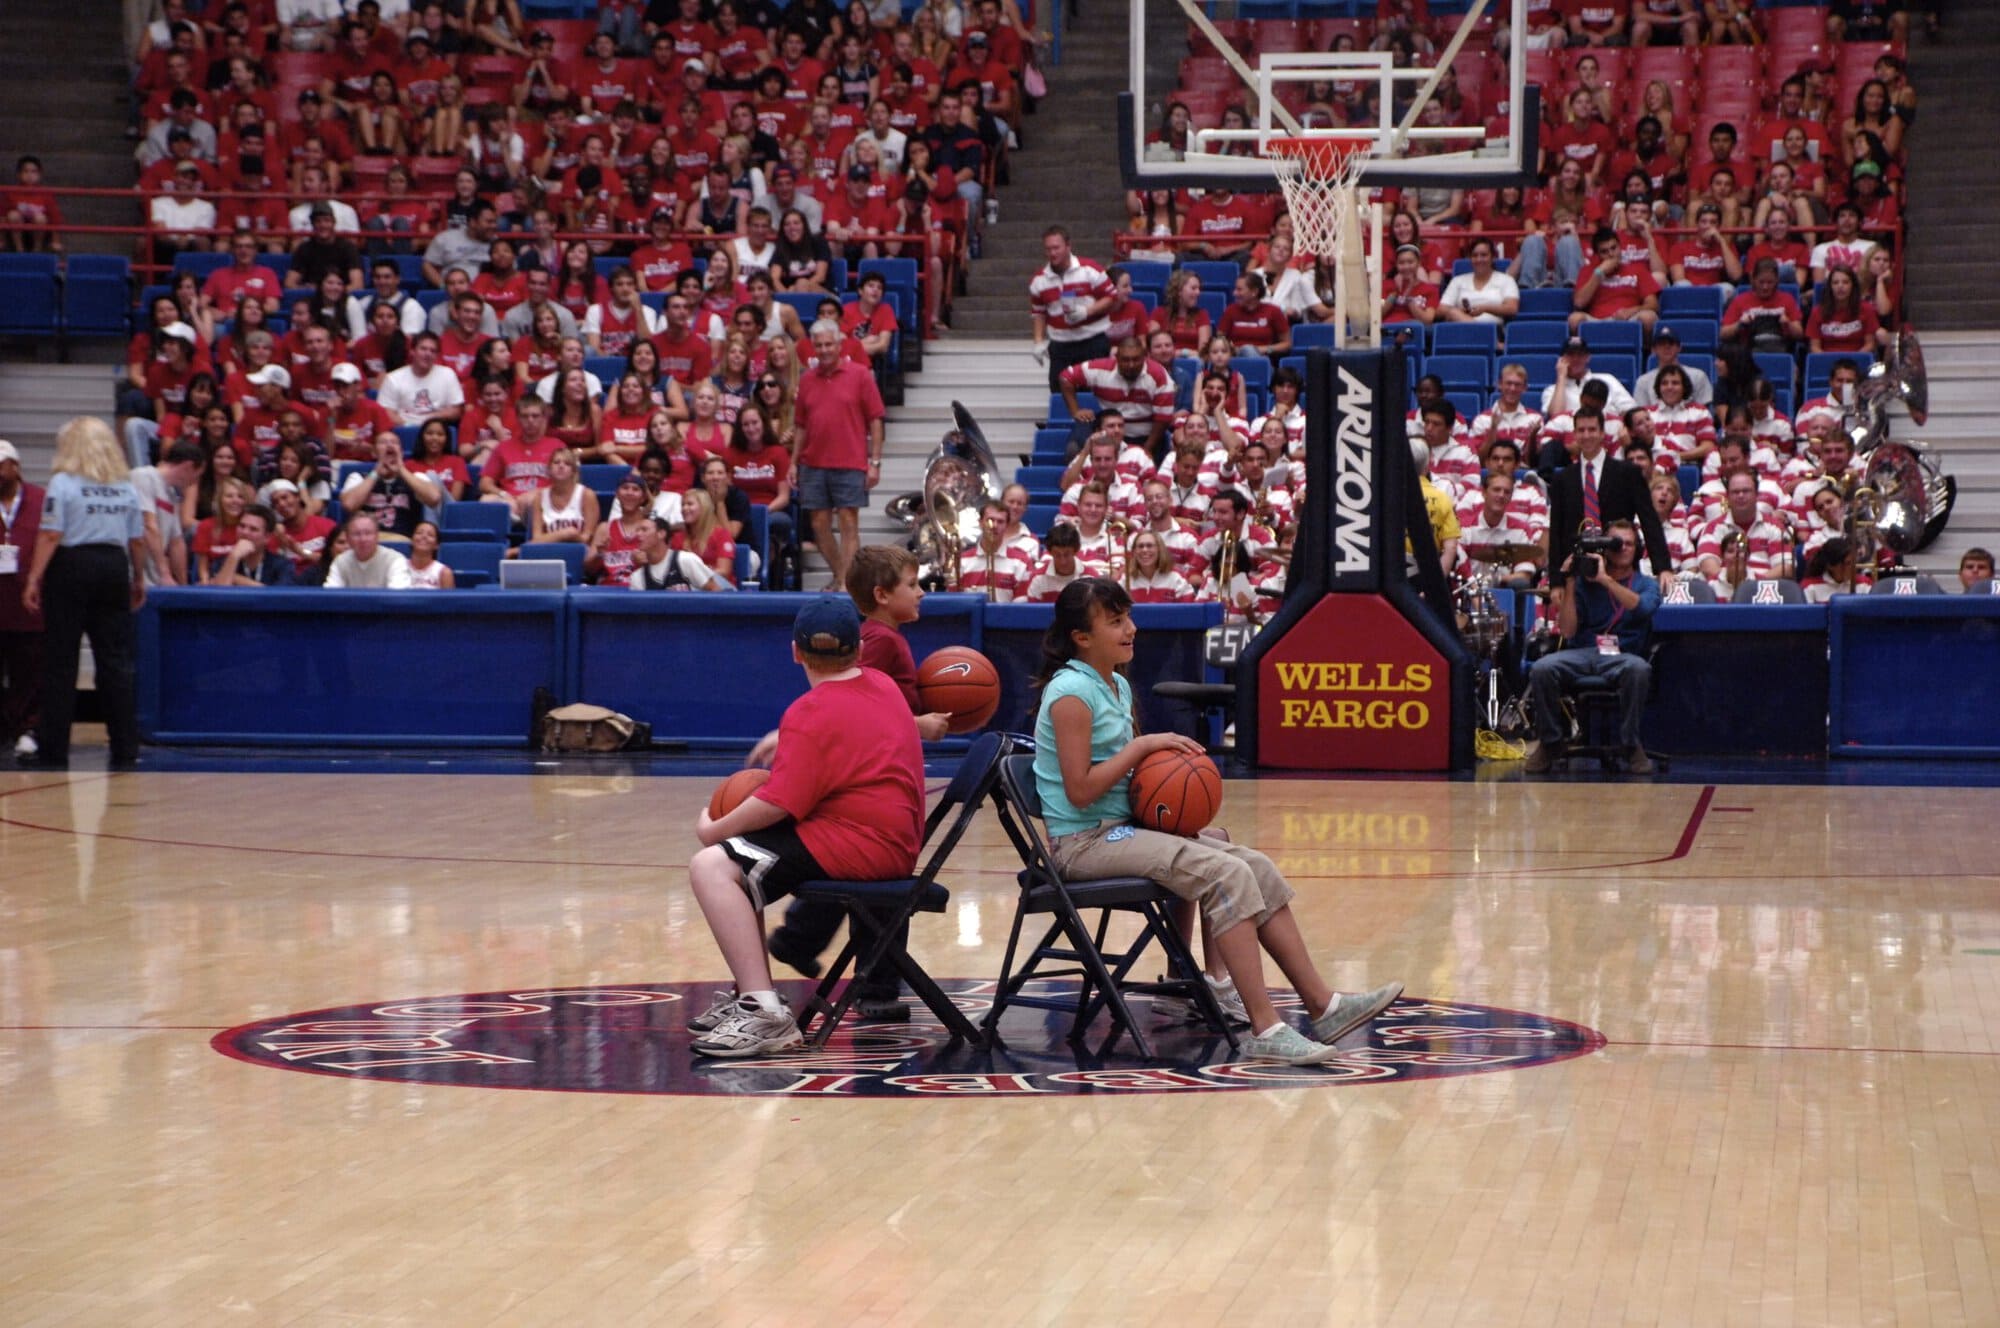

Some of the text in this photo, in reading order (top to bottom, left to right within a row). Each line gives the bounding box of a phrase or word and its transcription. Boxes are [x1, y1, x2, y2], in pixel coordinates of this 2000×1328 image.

[1335, 365, 1373, 572] ARIZONA
[1275, 663, 1432, 692] WELLS
[1280, 700, 1430, 729] FARGO
